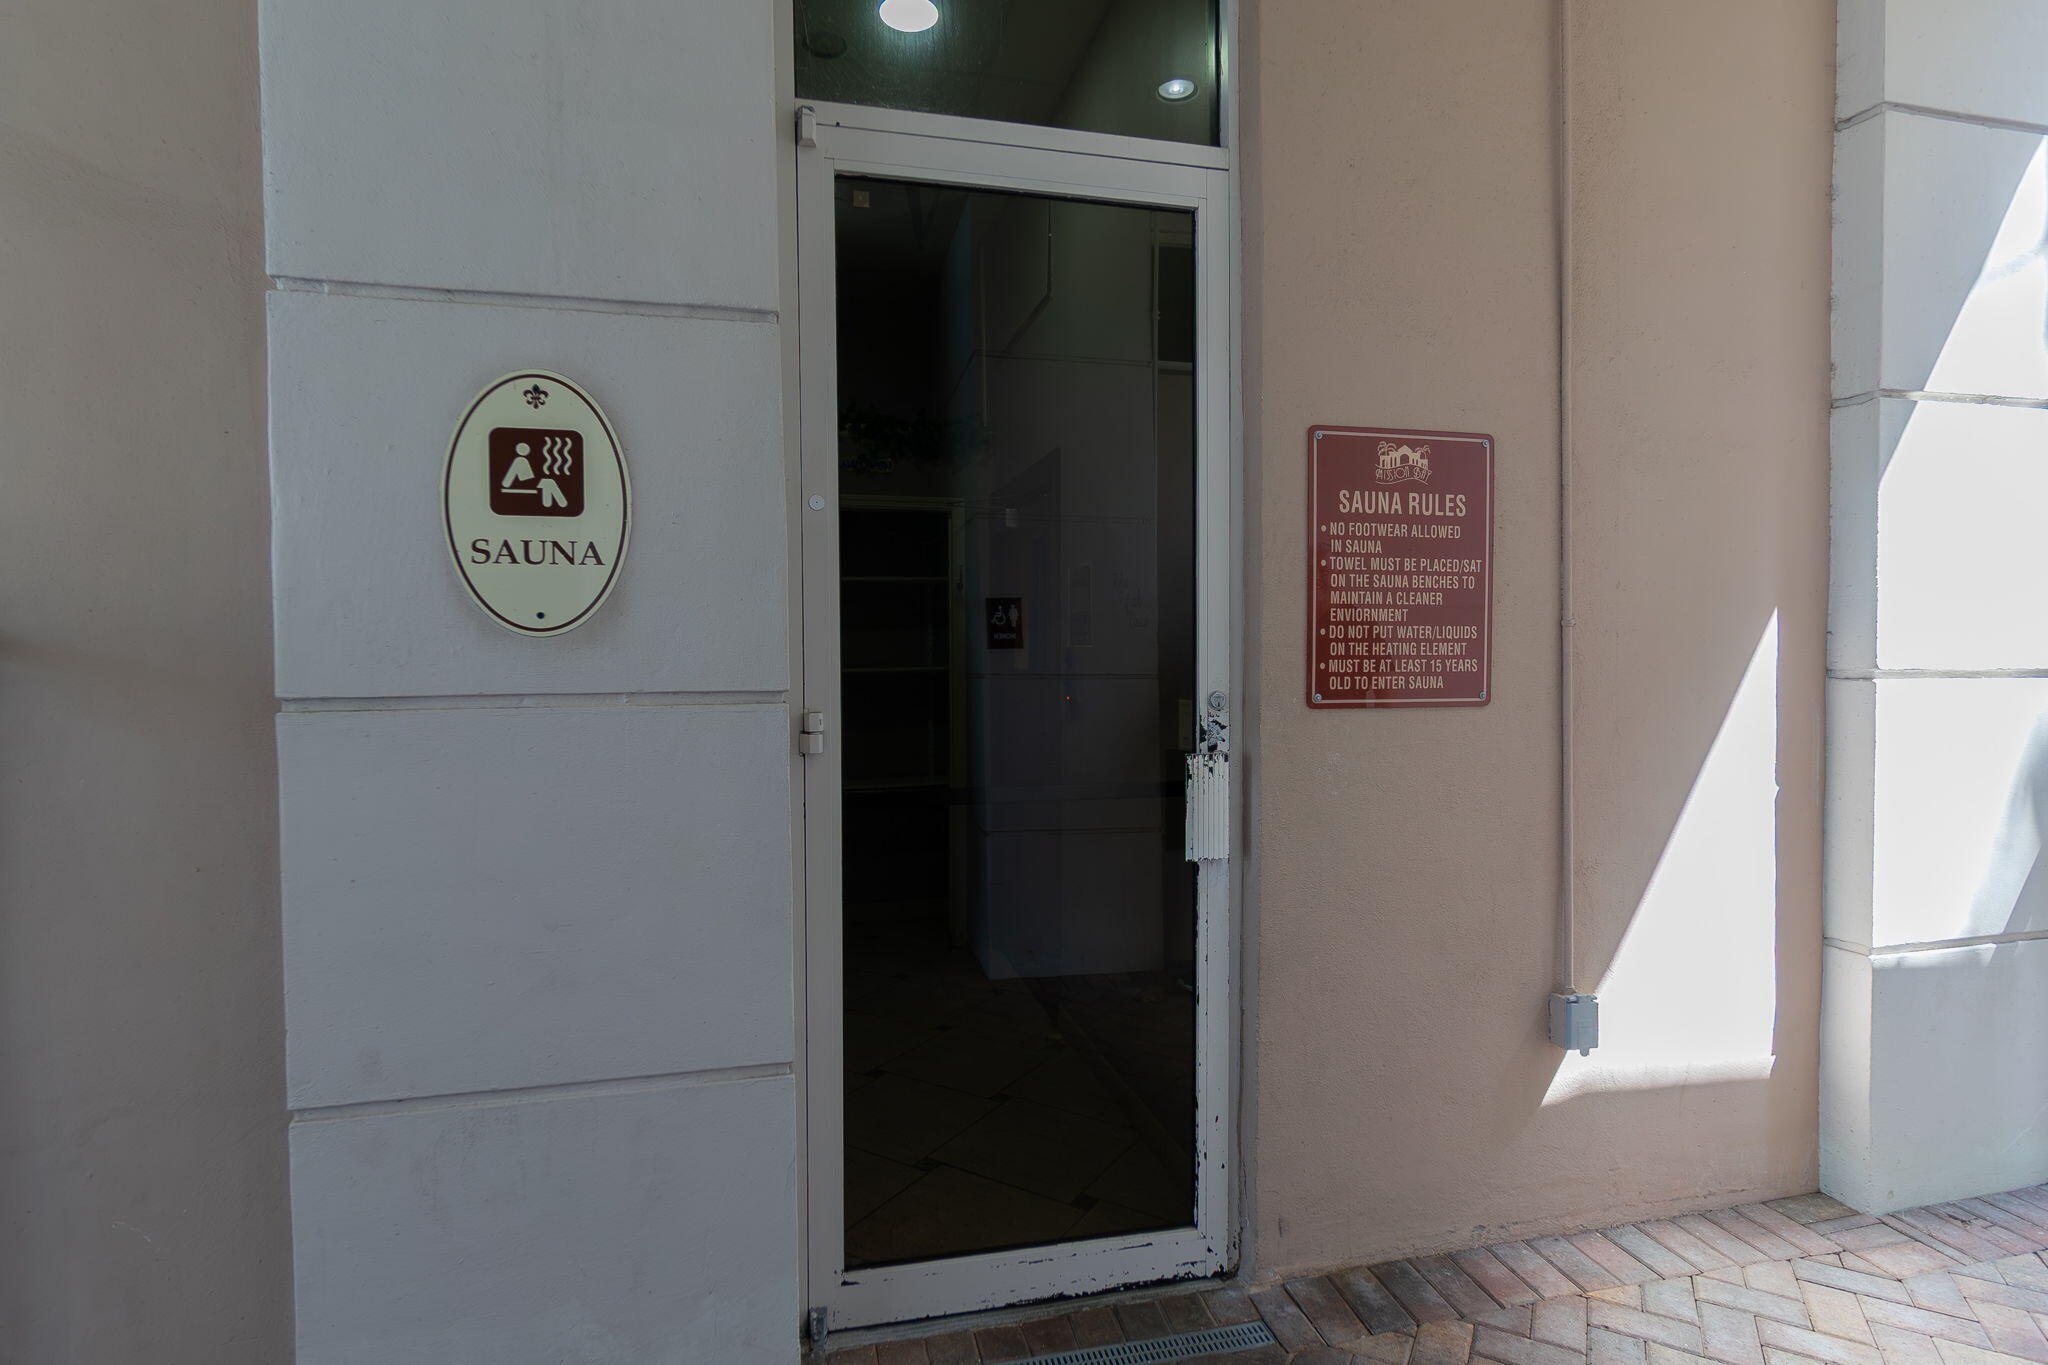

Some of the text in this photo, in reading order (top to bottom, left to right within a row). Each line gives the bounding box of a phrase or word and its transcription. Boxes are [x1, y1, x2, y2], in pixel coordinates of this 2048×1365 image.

[1376, 466, 1432, 482] MISSION BAY
[1339, 490, 1466, 517] SAUNA RULES
[1330, 522, 1461, 538] NO FOOTWEAR ALLOWED
[471, 539, 606, 565] SAUNA
[1331, 540, 1382, 554] IN SAUNA
[1330, 557, 1482, 573] TOWEL MUST BE PLACED/SAT
[1331, 574, 1474, 589] ON THE SAUNA BENCHES TO
[1330, 592, 1442, 605] MAINTAIN A CLEANER
[1330, 609, 1408, 621] ENVIORNMENT
[1330, 626, 1477, 639] DO NOT PUT WATER/LIQUIDS
[1330, 643, 1467, 655] ON THE HEATING ELEMENT
[1329, 660, 1478, 672] MUST BE AT LEAST 15 YEARS
[1330, 676, 1443, 690] OLD TO ENTER SAUNA
